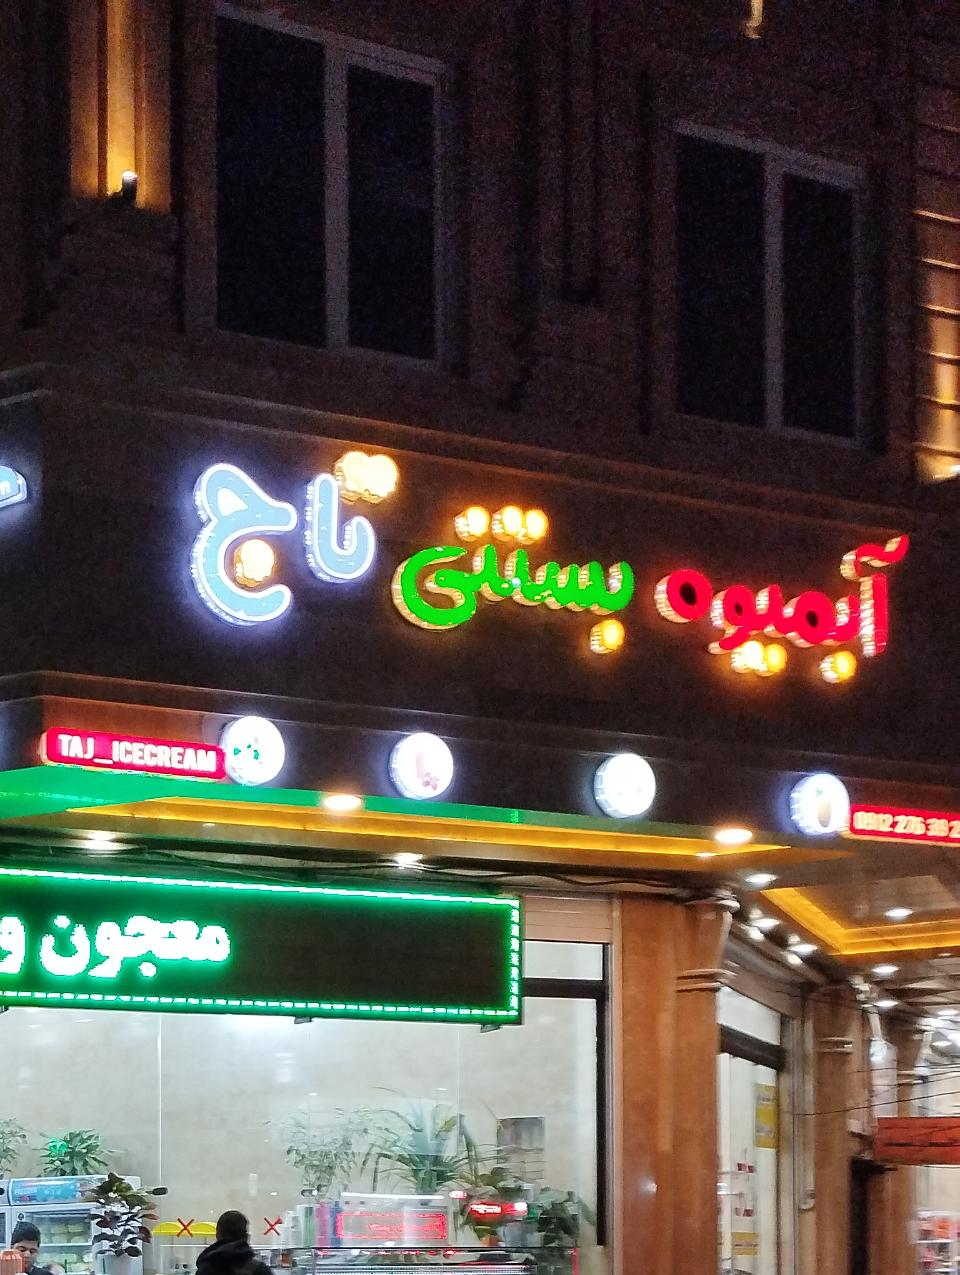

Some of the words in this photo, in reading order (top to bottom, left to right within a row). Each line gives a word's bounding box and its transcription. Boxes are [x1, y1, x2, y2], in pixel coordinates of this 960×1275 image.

[193, 452, 399, 626] تاج
[394, 505, 635, 654] بستنی
[654, 534, 909, 683] آبمیوه
[57, 734, 216, 772] TAJ_ICECREAM
[40, 915, 231, 977] معجون
